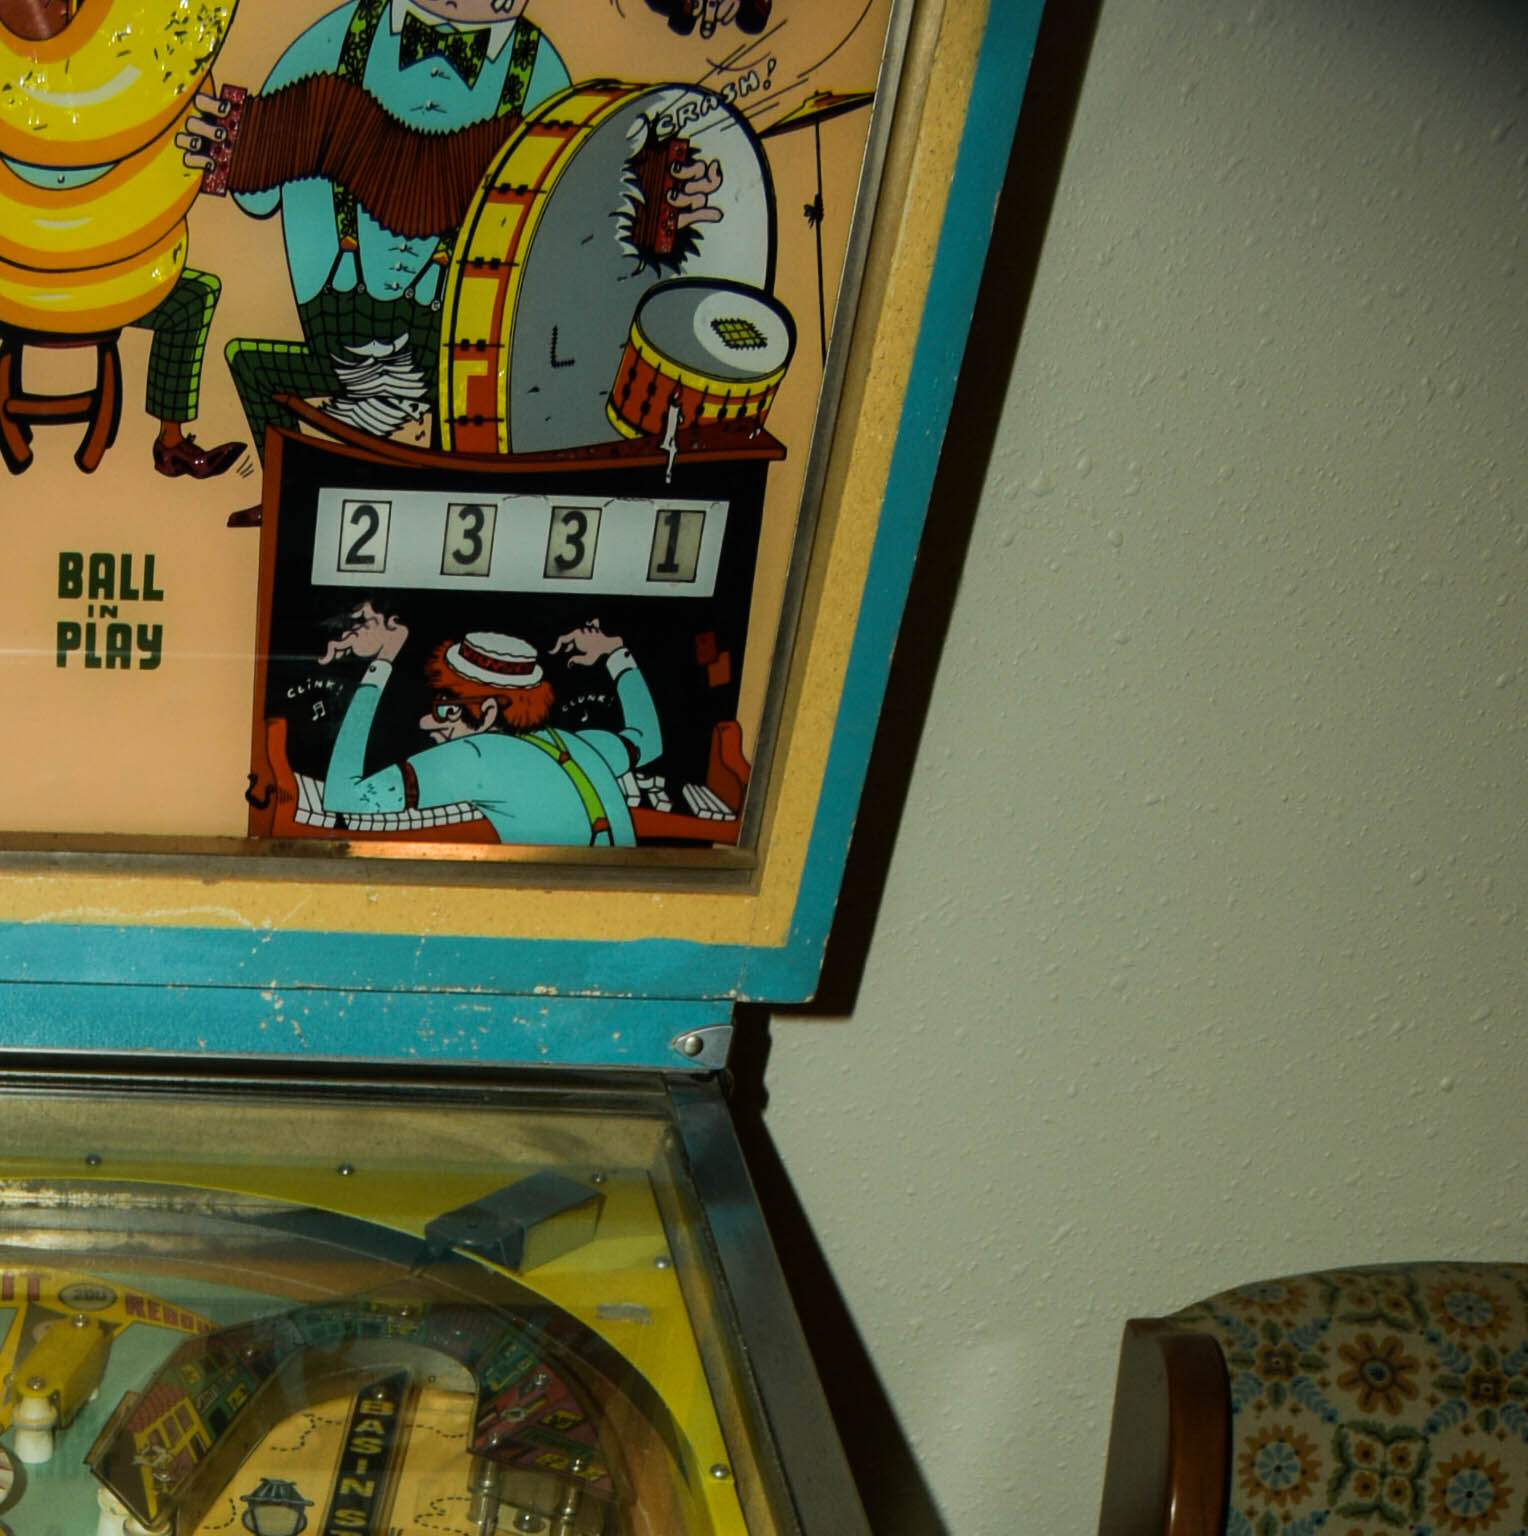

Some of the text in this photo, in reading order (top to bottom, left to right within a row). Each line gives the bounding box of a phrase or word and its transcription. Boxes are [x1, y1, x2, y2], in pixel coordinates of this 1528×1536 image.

[655, 57, 777, 141] CRASH!
[58, 551, 164, 602] BALL
[88, 604, 119, 619] IN
[56, 621, 163, 670] PLAY
